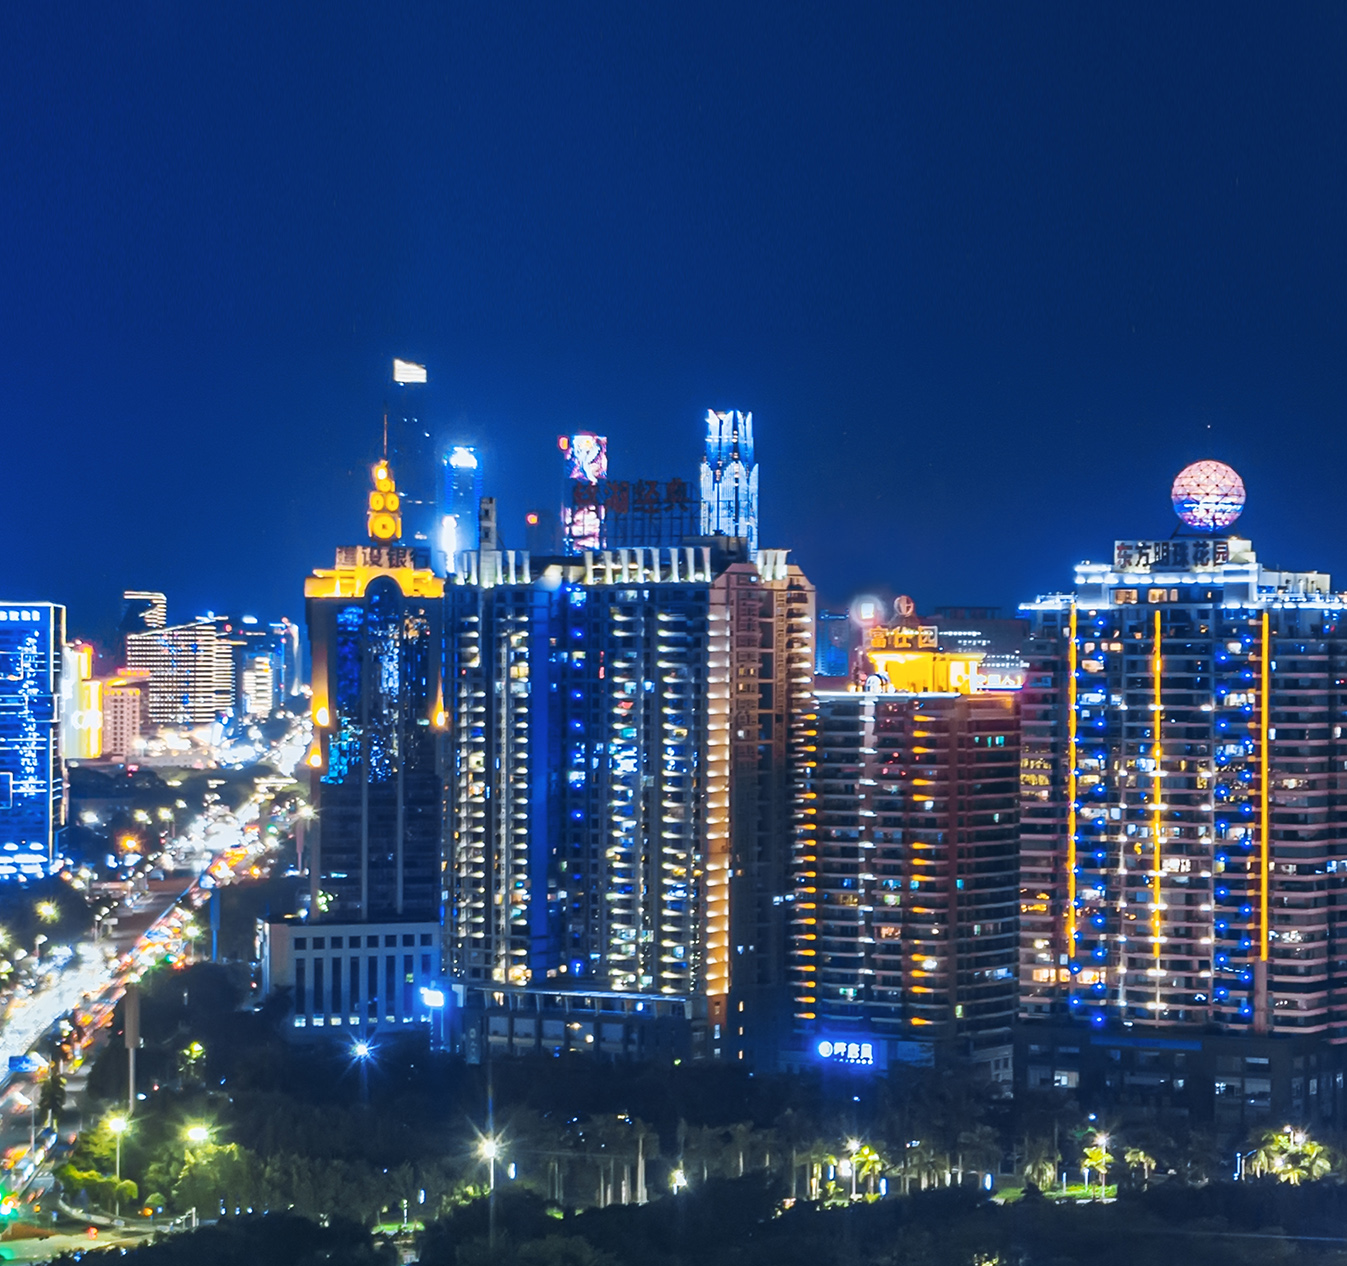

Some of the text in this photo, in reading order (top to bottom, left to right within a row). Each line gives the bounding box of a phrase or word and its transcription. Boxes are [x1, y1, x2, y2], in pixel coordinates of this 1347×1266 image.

[1116, 540, 1229, 568] 东方明珠花园
